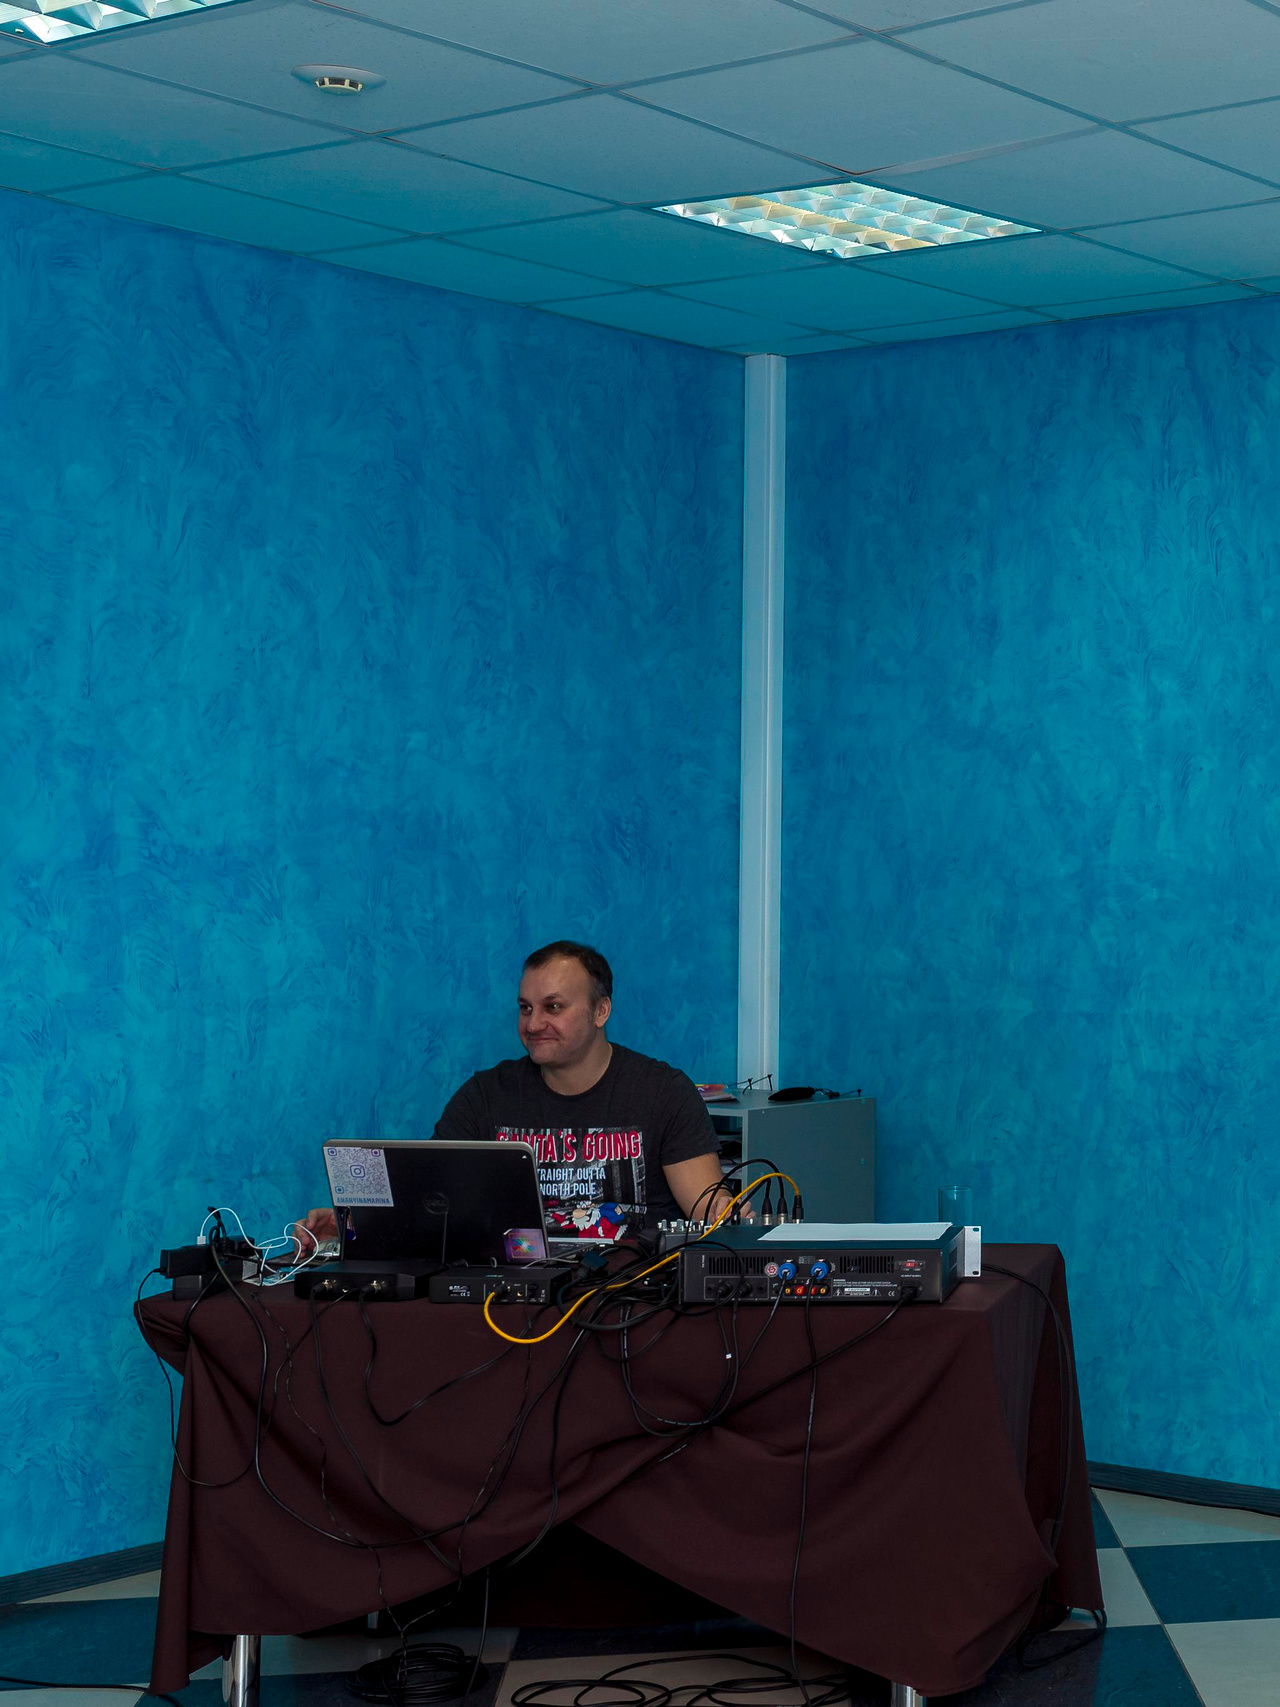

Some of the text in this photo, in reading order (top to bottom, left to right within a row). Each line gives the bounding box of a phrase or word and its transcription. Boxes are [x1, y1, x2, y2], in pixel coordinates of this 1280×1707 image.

[496, 1130, 641, 1163] TA'S GOING
[537, 1167, 606, 1181] TRAIGHT OUTTA
[540, 1182, 597, 1196] NORTH POLE
